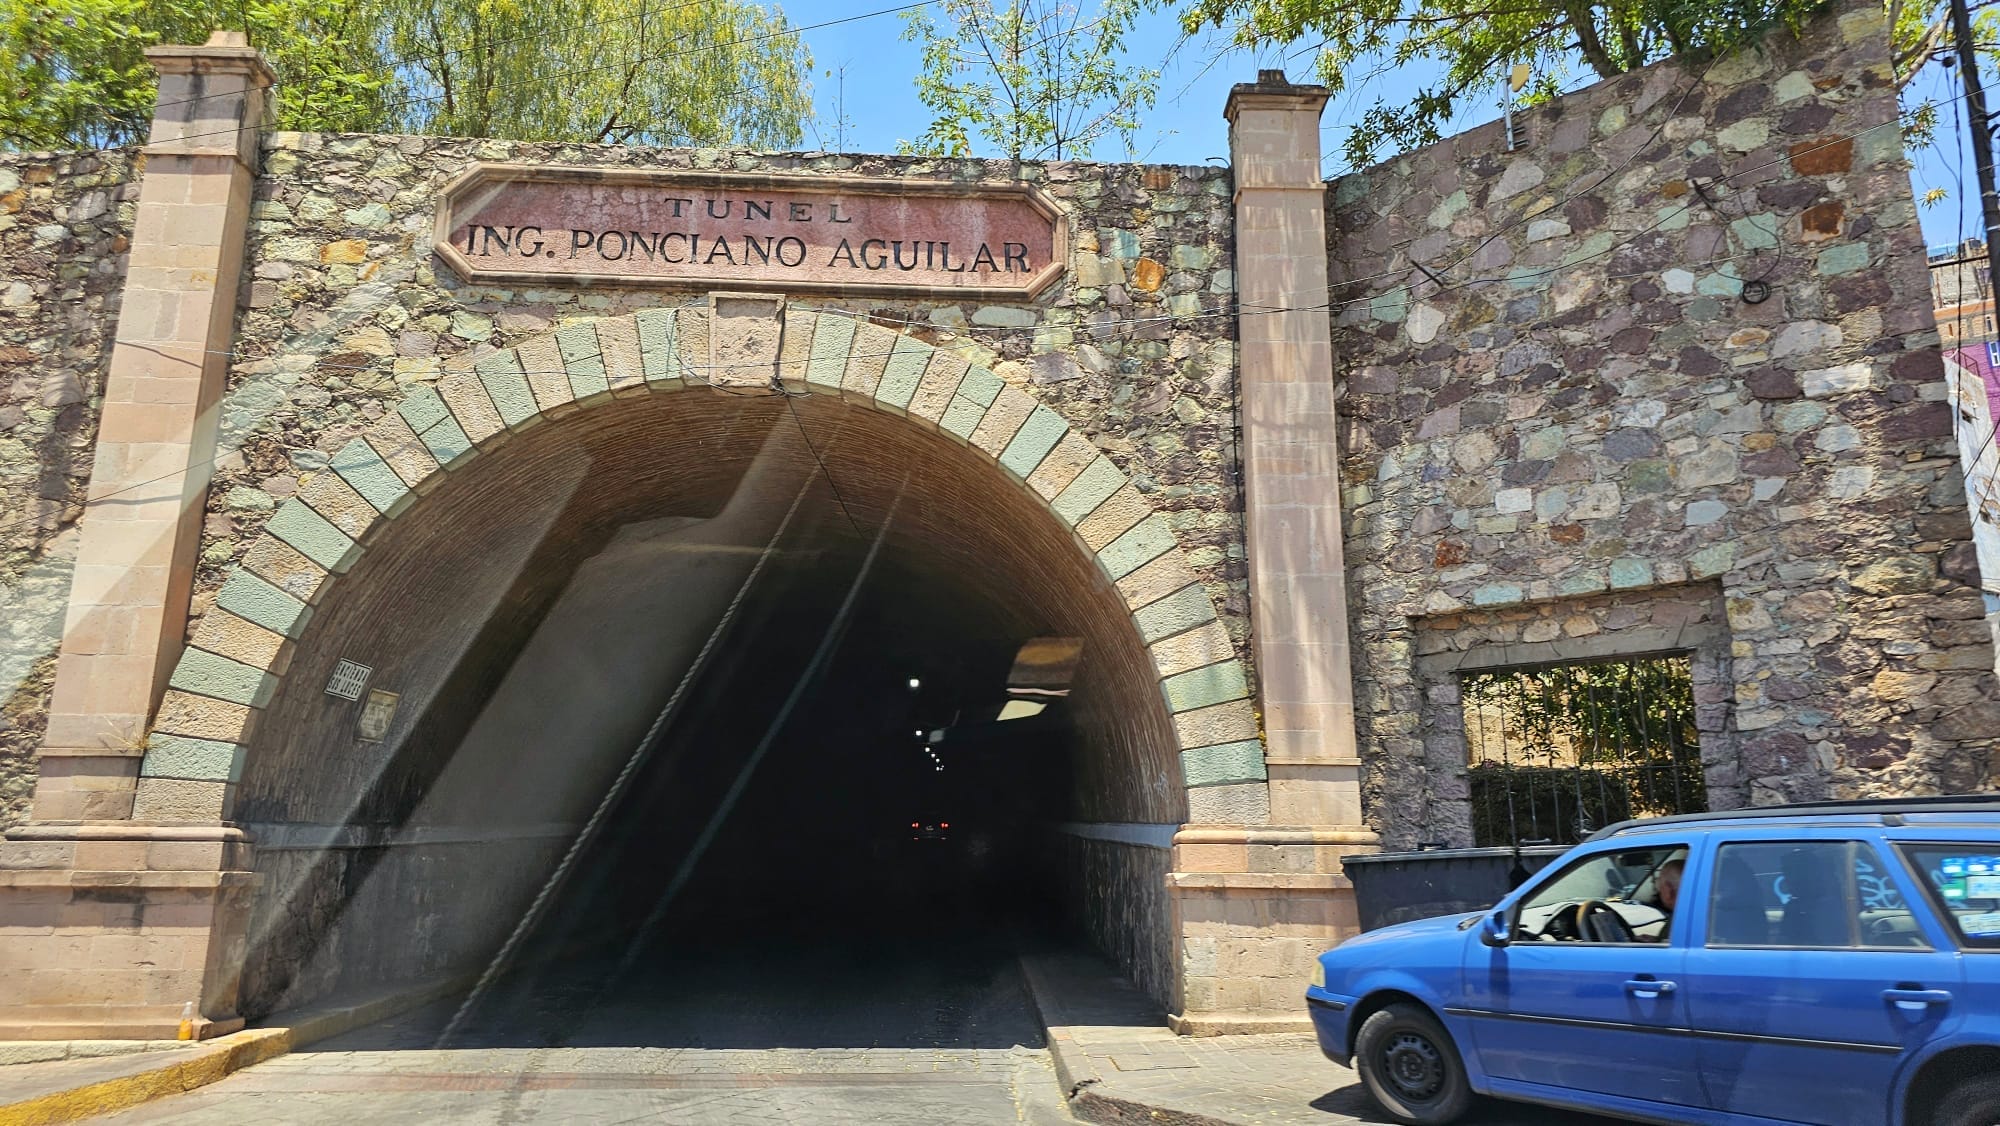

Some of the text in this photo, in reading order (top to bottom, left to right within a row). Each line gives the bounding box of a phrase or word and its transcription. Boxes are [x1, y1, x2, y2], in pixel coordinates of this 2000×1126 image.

[664, 197, 852, 224] TUNEL
[465, 223, 1032, 273] ING. PONCIANO AGUILAR
[328, 676, 361, 697] SUS LUCES
